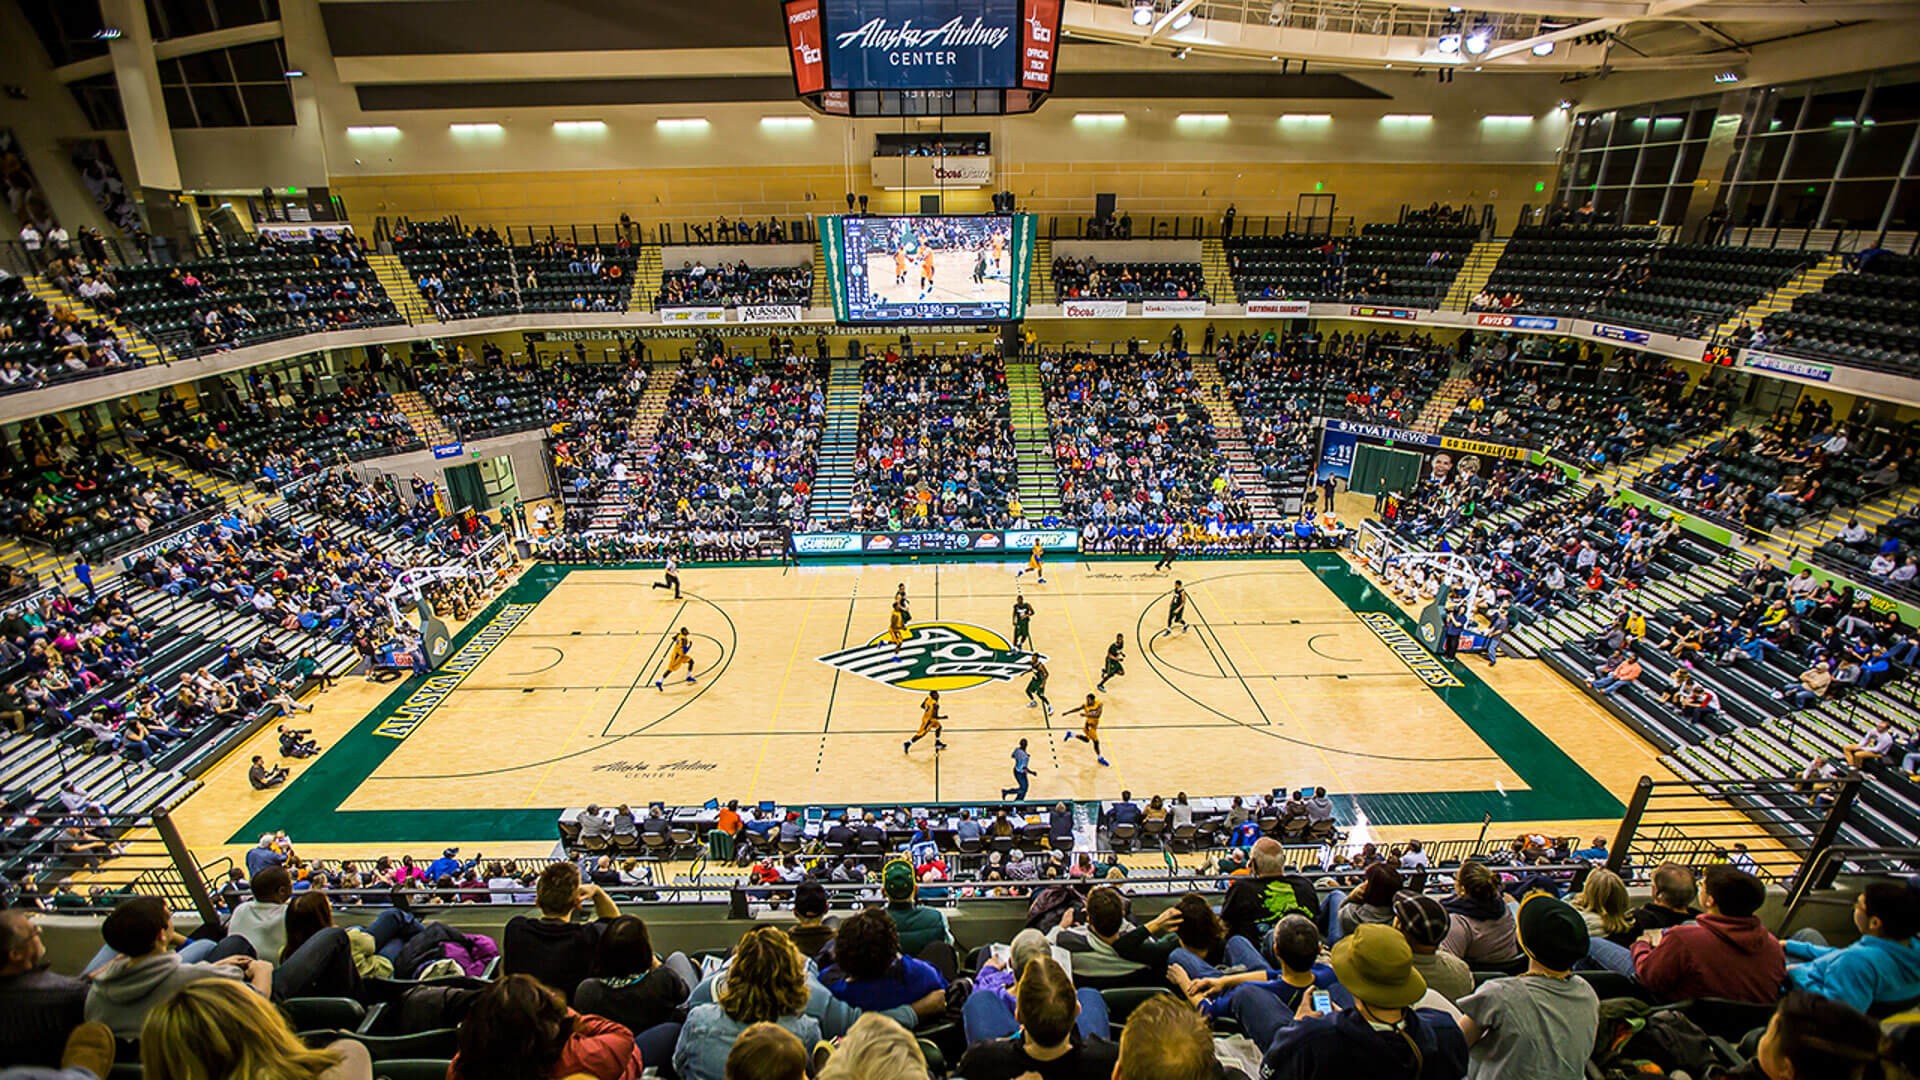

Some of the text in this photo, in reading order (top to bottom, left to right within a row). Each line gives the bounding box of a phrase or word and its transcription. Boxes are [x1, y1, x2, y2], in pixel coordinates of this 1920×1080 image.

[836, 16, 1008, 51] Alaska Airlines
[1033, 27, 1051, 42] GCI
[803, 48, 821, 64] GCI
[889, 52, 957, 66] CENTER
[1027, 48, 1049, 60] OFFICIAL
[1023, 70, 1048, 82] PARTNER
[743, 305, 797, 321] ALASKAN
[1067, 305, 1095, 317] Coors
[1481, 315, 1503, 326] AVIS
[1349, 423, 1380, 436] KTVA
[1392, 429, 1428, 444] NEWS
[1339, 445, 1352, 459] 11
[801, 535, 852, 551] SUBWAY
[1854, 589, 1897, 611] SUBWAY
[1356, 612, 1464, 687] SEAWOLVES
[372, 603, 537, 738] ALASKA ANCHORAGE
